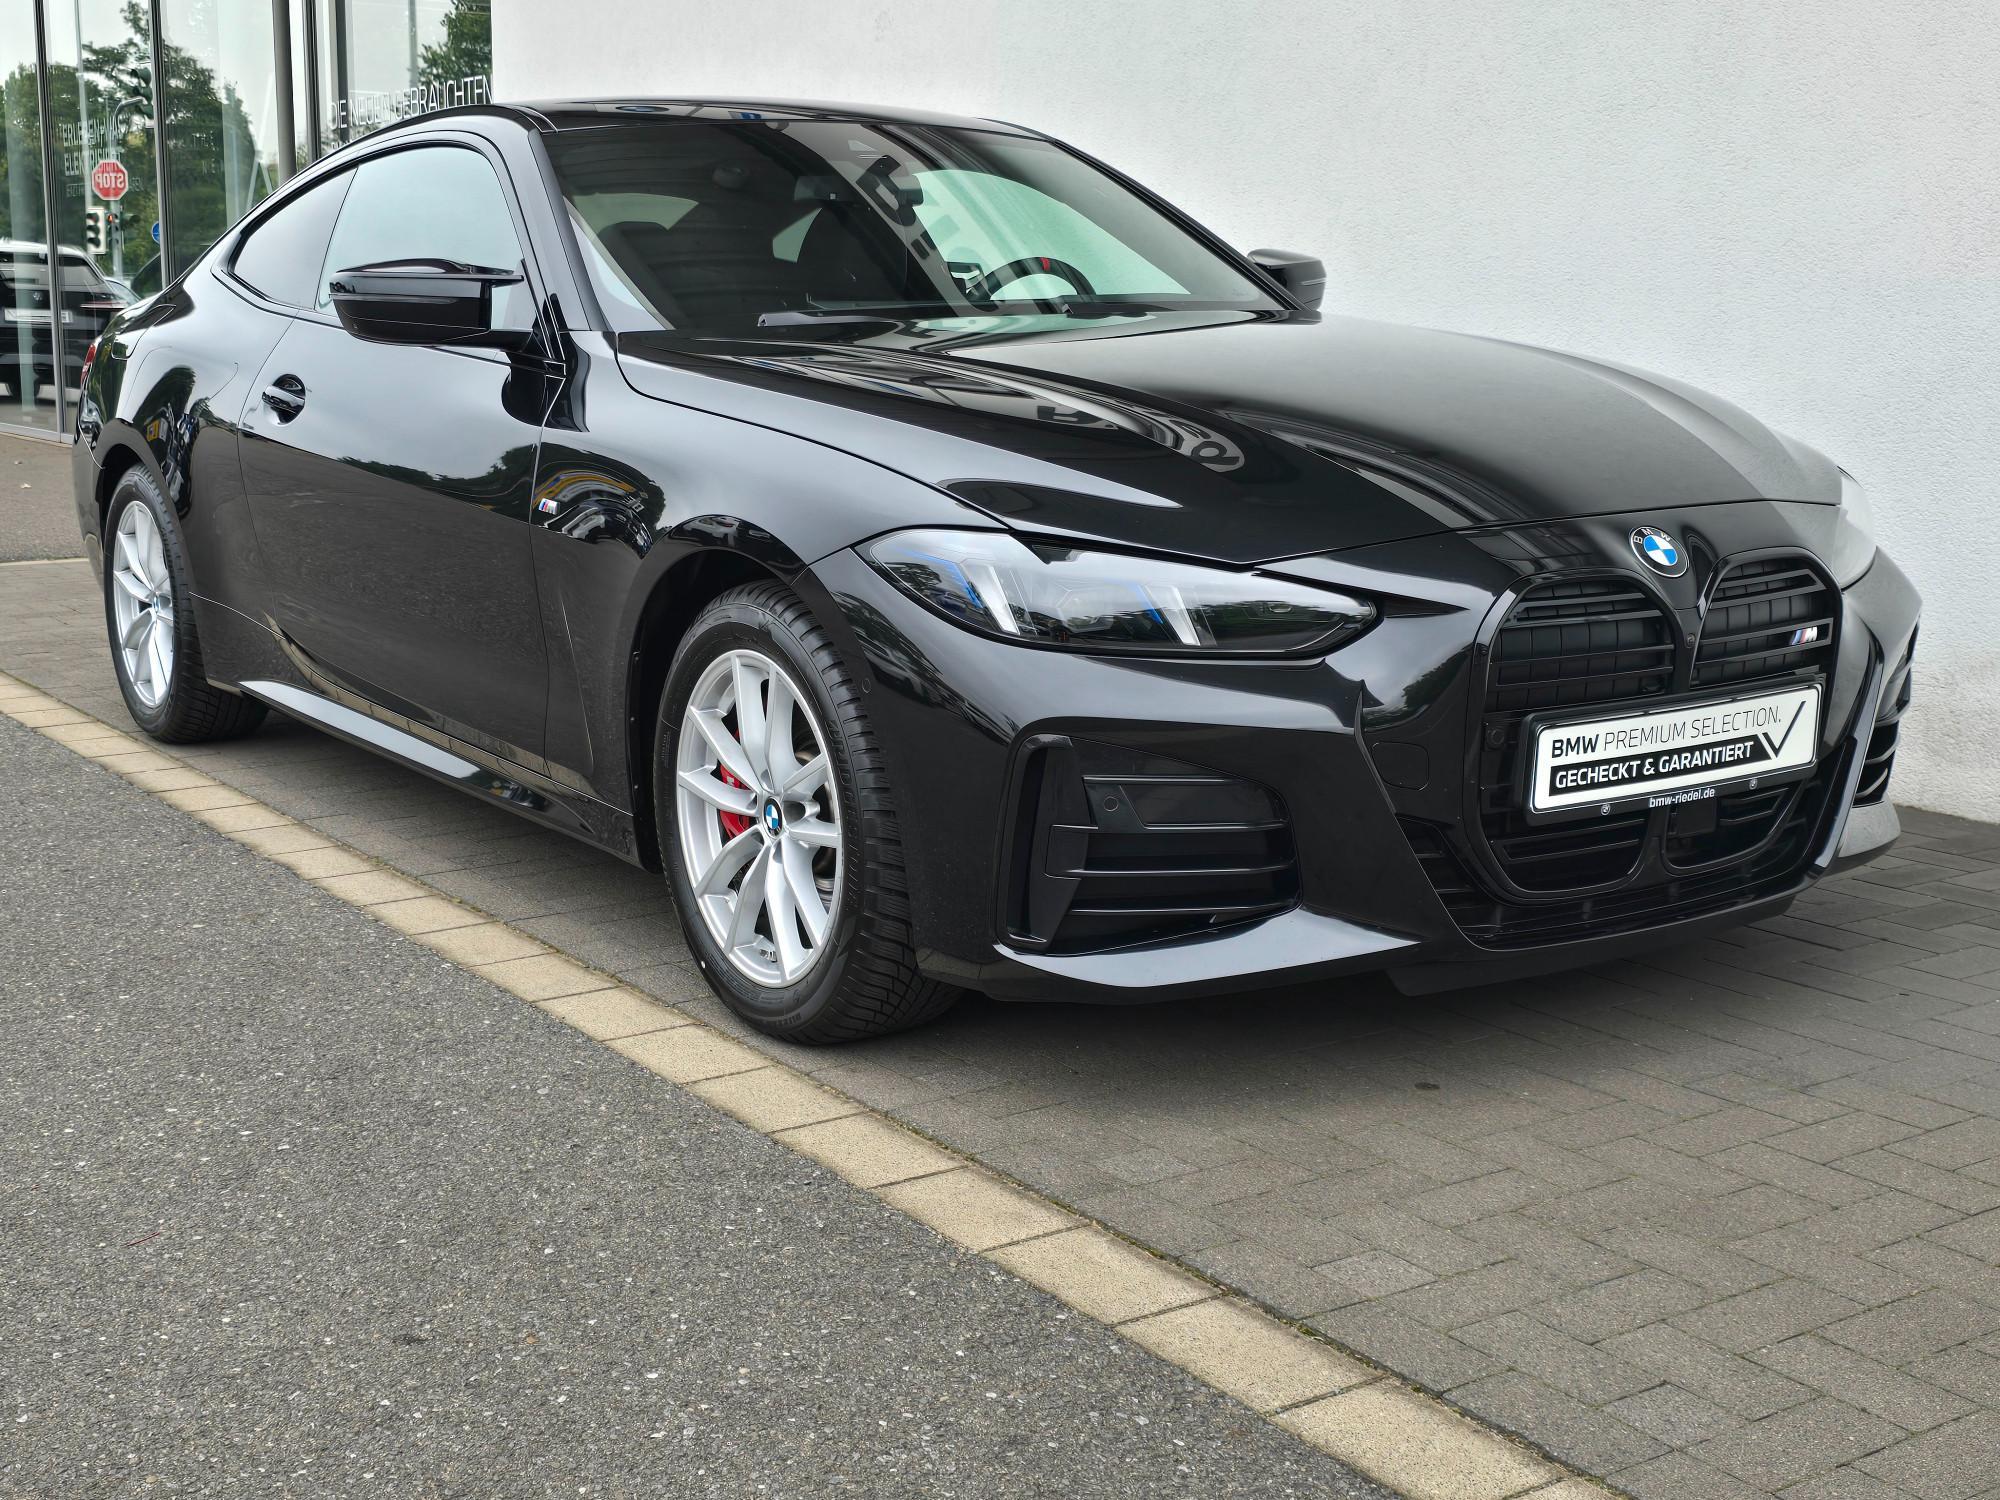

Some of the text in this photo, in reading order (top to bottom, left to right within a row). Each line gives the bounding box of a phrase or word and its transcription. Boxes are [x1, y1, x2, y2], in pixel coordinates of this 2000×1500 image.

[1552, 734, 1599, 758] BMW
[1604, 721, 1686, 751] PREMIUM
[1556, 741, 1754, 788] GECHECKT & GARANTIERT
[1649, 788, 1716, 807] bmw-riedel.de
